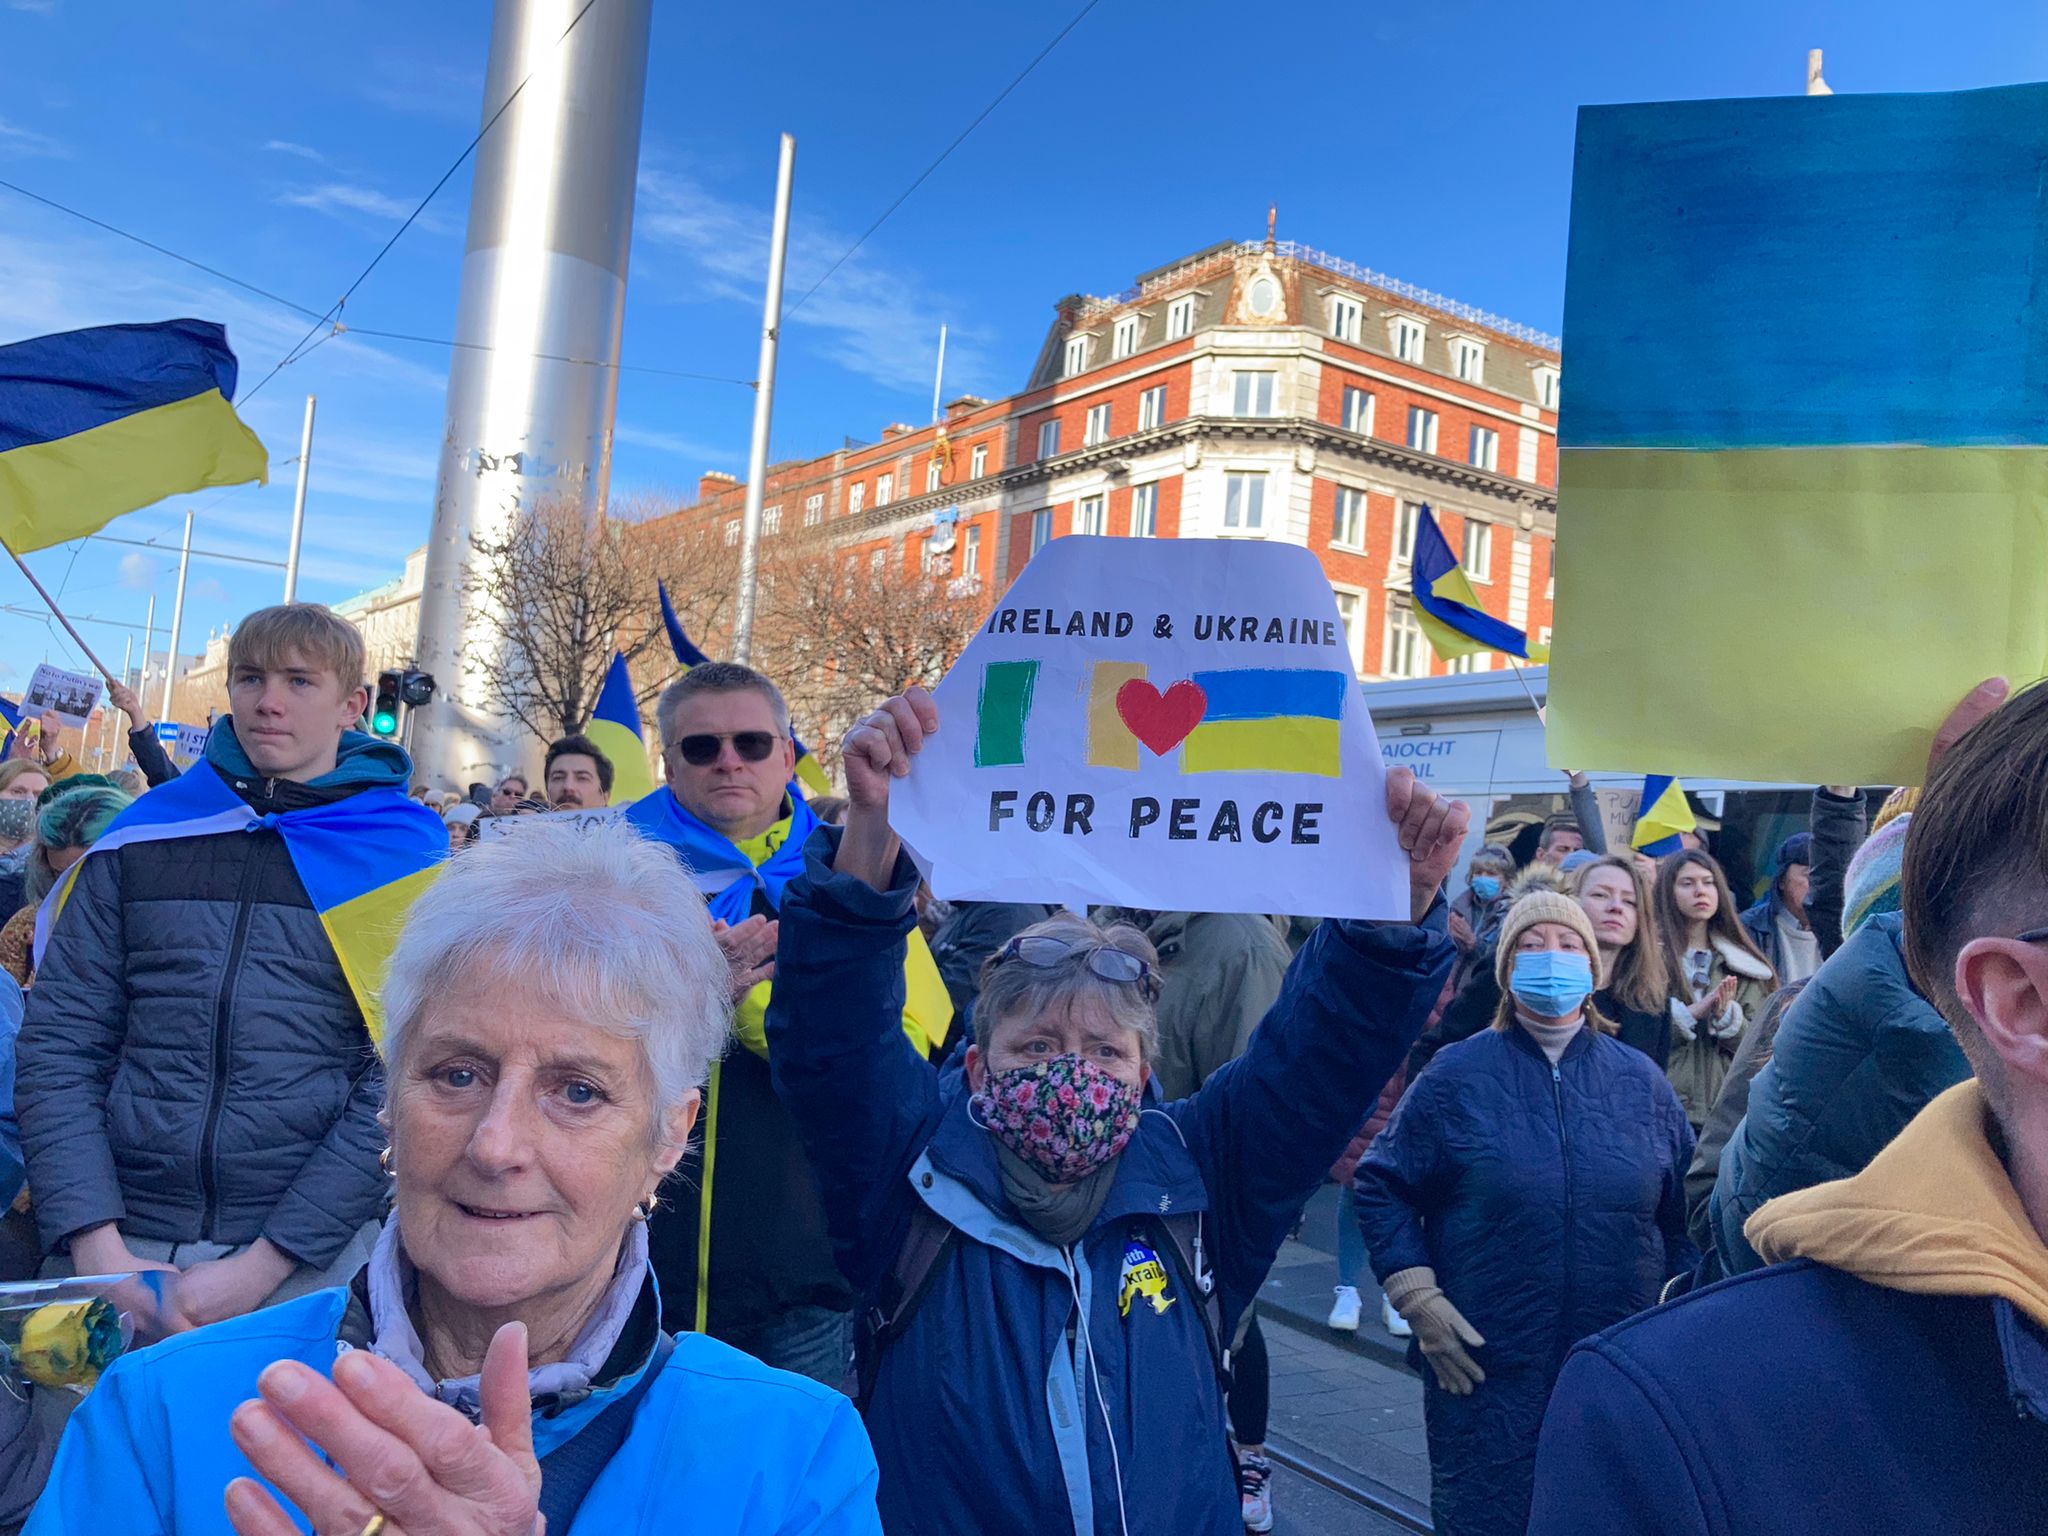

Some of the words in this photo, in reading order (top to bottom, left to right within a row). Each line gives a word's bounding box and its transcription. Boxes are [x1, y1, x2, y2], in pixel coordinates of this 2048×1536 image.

[987, 608, 1134, 638] IRELAND
[1152, 613, 1174, 640] &
[1193, 615, 1337, 647] UKRAINE
[192, 734, 205, 745] ST
[1382, 741, 1456, 758] AIOCHT
[1605, 792, 1641, 809] PUT
[989, 790, 1095, 836] FOR
[1129, 797, 1324, 845] PEACE
[1125, 1248, 1146, 1264] ith
[1123, 1262, 1165, 1286] krai
